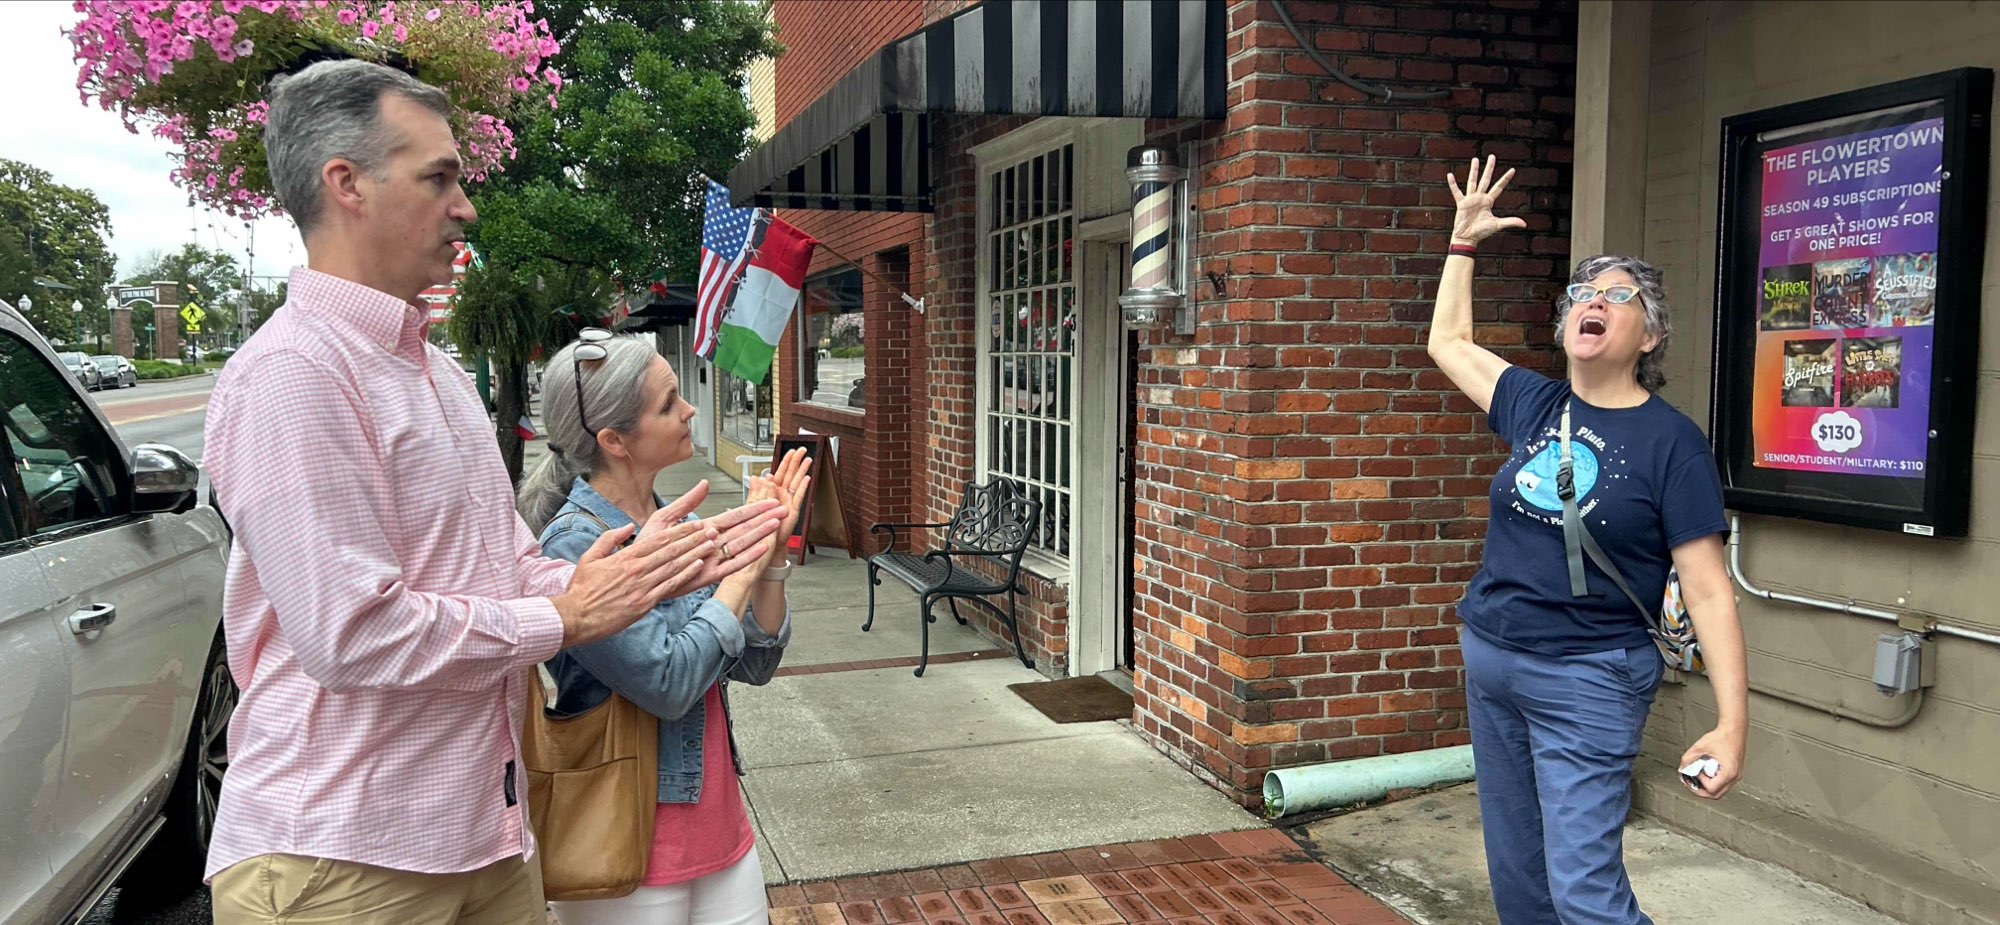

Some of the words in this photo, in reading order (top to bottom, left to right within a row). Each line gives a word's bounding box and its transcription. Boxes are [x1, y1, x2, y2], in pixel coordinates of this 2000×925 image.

[1766, 154, 1797, 173] THE
[1801, 126, 1943, 166] FLOWERTOWN
[1807, 157, 1891, 186] PLAYERS
[1763, 199, 1810, 217] SEASON
[1813, 196, 1829, 210] 49
[1833, 181, 1941, 206] SUBSCRIPTIONS
[1770, 228, 1792, 242] GET
[1795, 227, 1801, 239] 5
[1804, 221, 1845, 239] GREAT
[1848, 214, 1899, 232] SHOWS
[1903, 211, 1935, 226] FOR
[1809, 237, 1835, 251] ONE
[1838, 232, 1882, 248] PRICE!
[1873, 274, 1937, 300] SEUSSIFIED
[1784, 361, 1834, 388] Spitfire
[1818, 424, 1855, 441] $130
[1764, 452, 1897, 469] SENIOR/STUDENT/MILITARY:
[1899, 460, 1924, 471] $110
